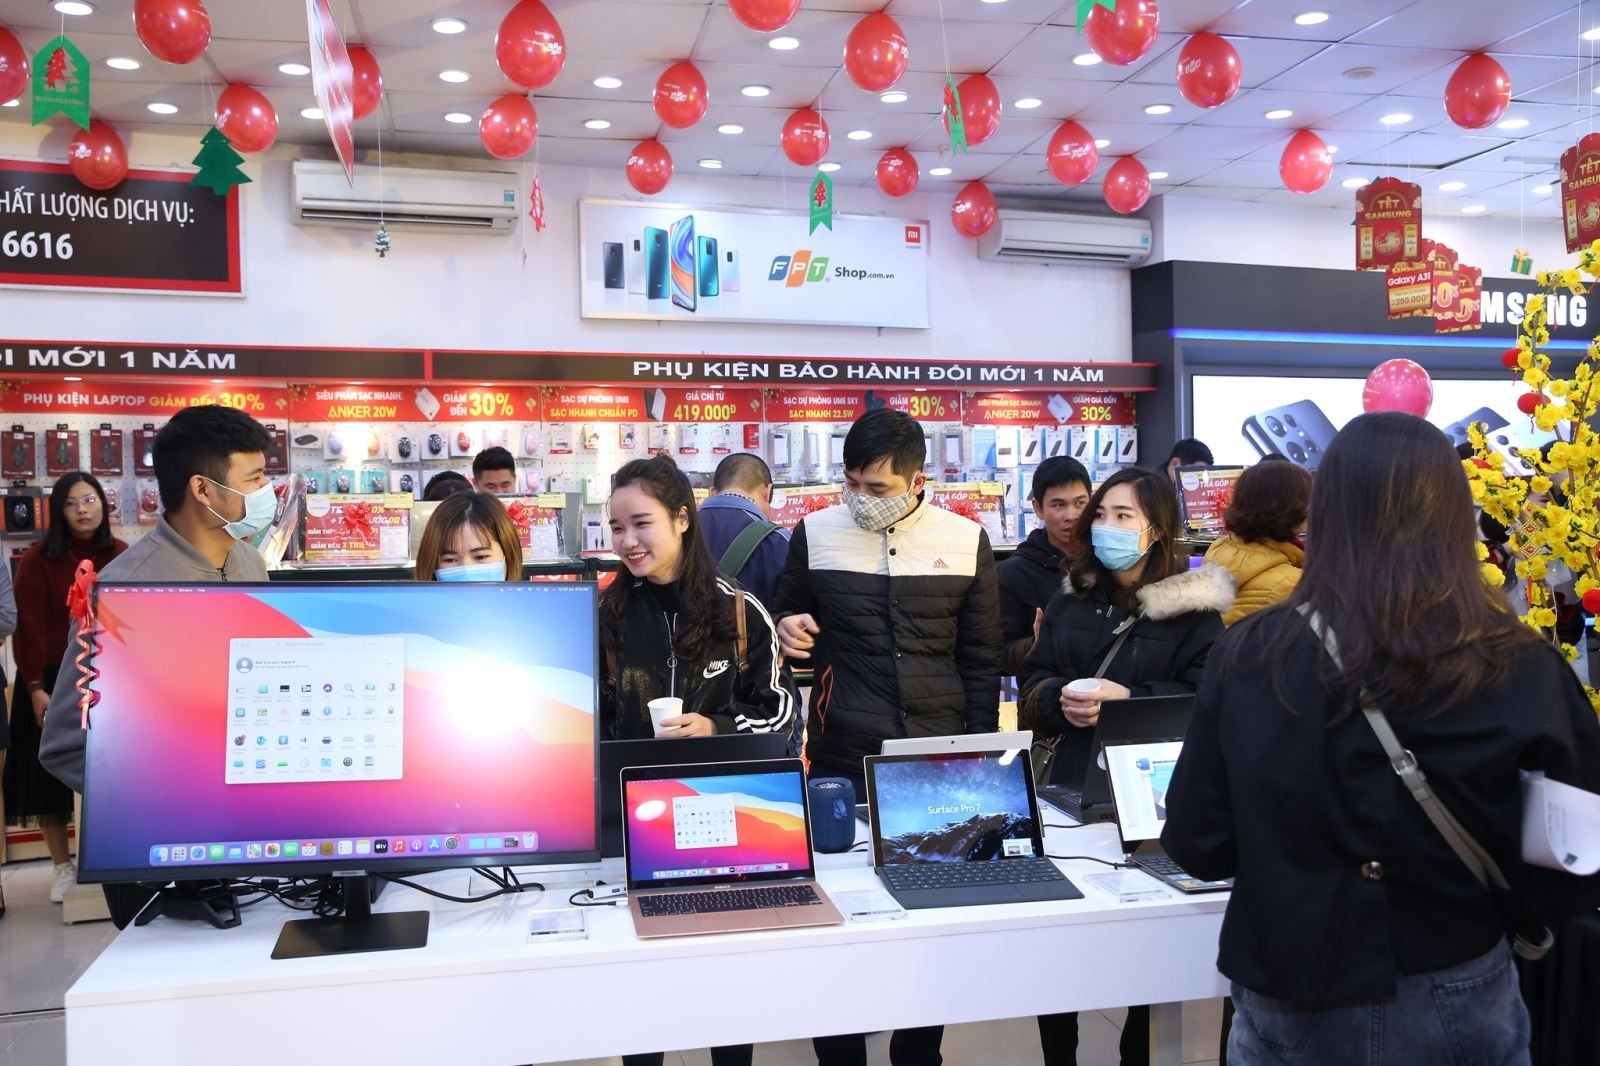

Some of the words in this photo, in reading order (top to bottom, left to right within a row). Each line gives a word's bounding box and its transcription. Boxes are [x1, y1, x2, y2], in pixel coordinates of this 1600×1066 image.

[41, 191, 108, 221] LƯỢNG
[114, 198, 158, 224] DỊCH
[162, 200, 194, 227] VỤ:
[1364, 210, 1412, 220] SAMSUNG
[2, 230, 74, 260] 6616
[1388, 276, 1415, 286] Galaxy
[1481, 291, 1587, 327] MSNG
[0, 349, 13, 366] I
[28, 347, 105, 368] MỚI
[120, 351, 135, 368] 1
[153, 349, 236, 369] NĂM
[633, 361, 693, 380] PHỤ
[704, 362, 769, 381] KIỆN
[779, 361, 838, 379] BẢO
[847, 362, 920, 379] HÀNH
[980, 365, 1025, 381] MỚI
[1033, 368, 1043, 381] 1
[1053, 366, 1103, 382] NĂM
[24, 393, 53, 407] PHỤ
[57, 392, 89, 407] KIỆN
[94, 394, 145, 407] LAPTOP
[149, 393, 186, 407] GIẢM
[219, 392, 265, 411] 30%
[443, 390, 467, 403] GIẢM
[889, 394, 908, 405] GIẢM
[469, 392, 514, 416] 30%
[910, 395, 945, 417] 30%
[328, 406, 371, 419] ANKER
[373, 406, 397, 418] 20W
[569, 408, 597, 417] NHANH
[628, 409, 638, 417] PD
[789, 409, 804, 420] SẠC
[805, 410, 831, 418] NHANH
[832, 410, 854, 418] 22.5W
[983, 409, 1019, 420] ANKER
[1020, 409, 1040, 419] 20W
[1080, 406, 1112, 421] 30%
[708, 659, 729, 671] NIKE
[927, 805, 959, 815] Surface
[960, 804, 975, 812] Pro
